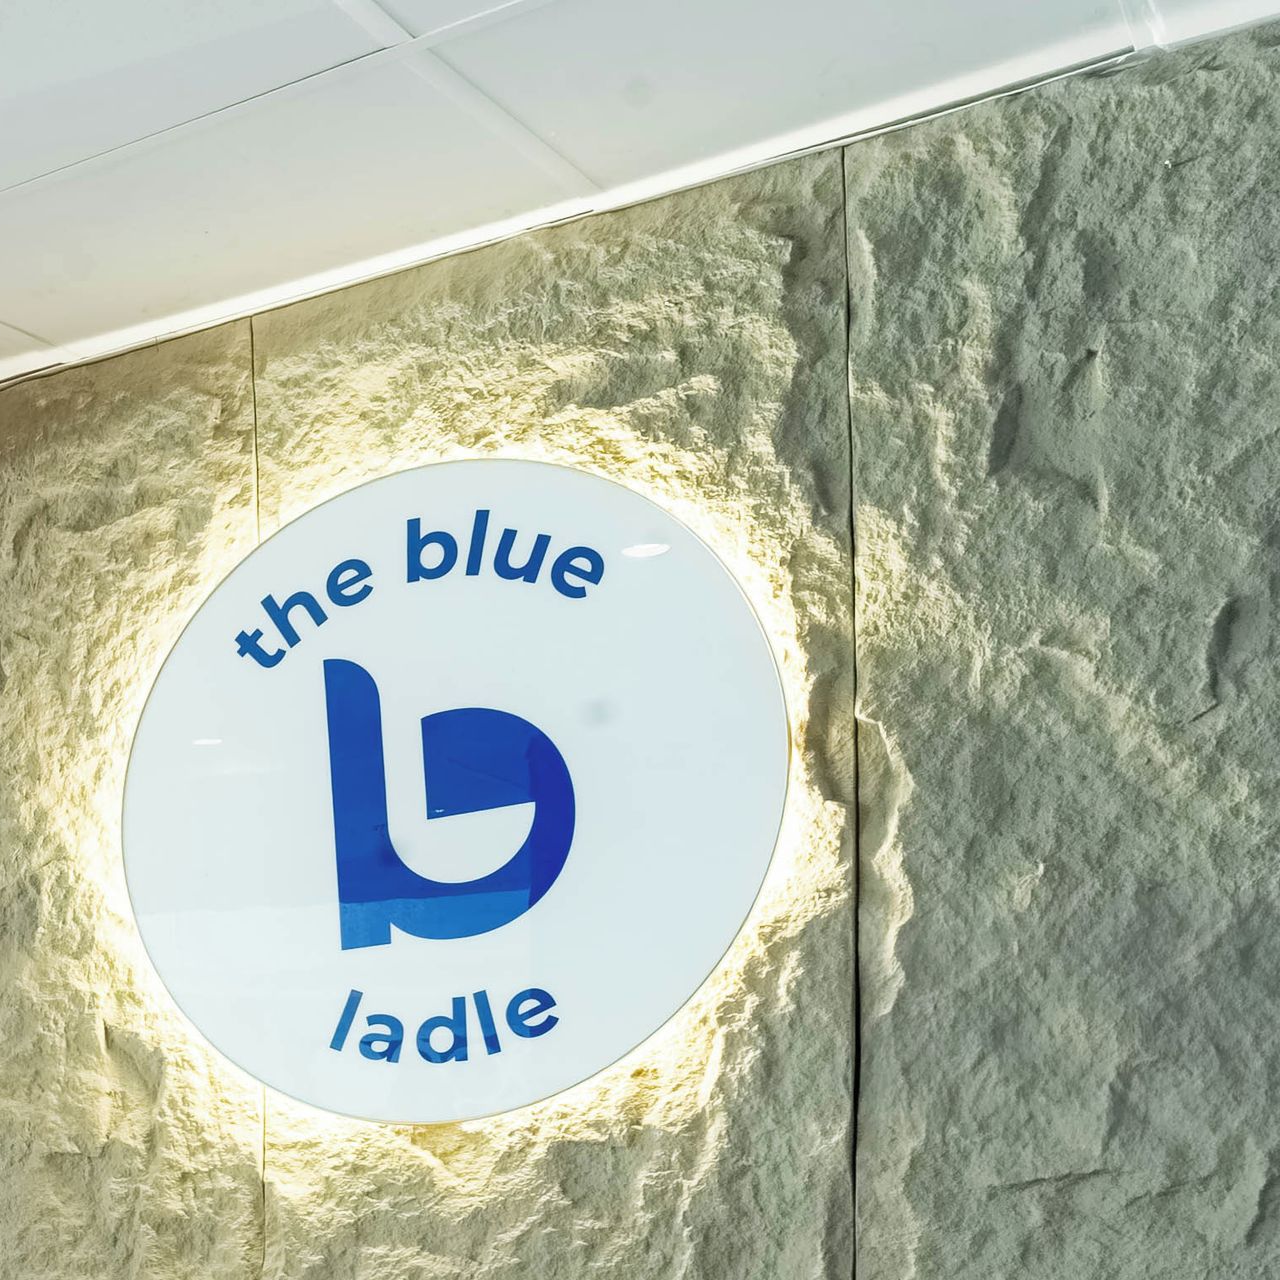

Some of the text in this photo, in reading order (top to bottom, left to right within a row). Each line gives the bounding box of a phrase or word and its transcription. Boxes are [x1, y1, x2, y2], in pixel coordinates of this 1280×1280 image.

[234, 509, 605, 668] the blue
[329, 986, 560, 1064] ladle
